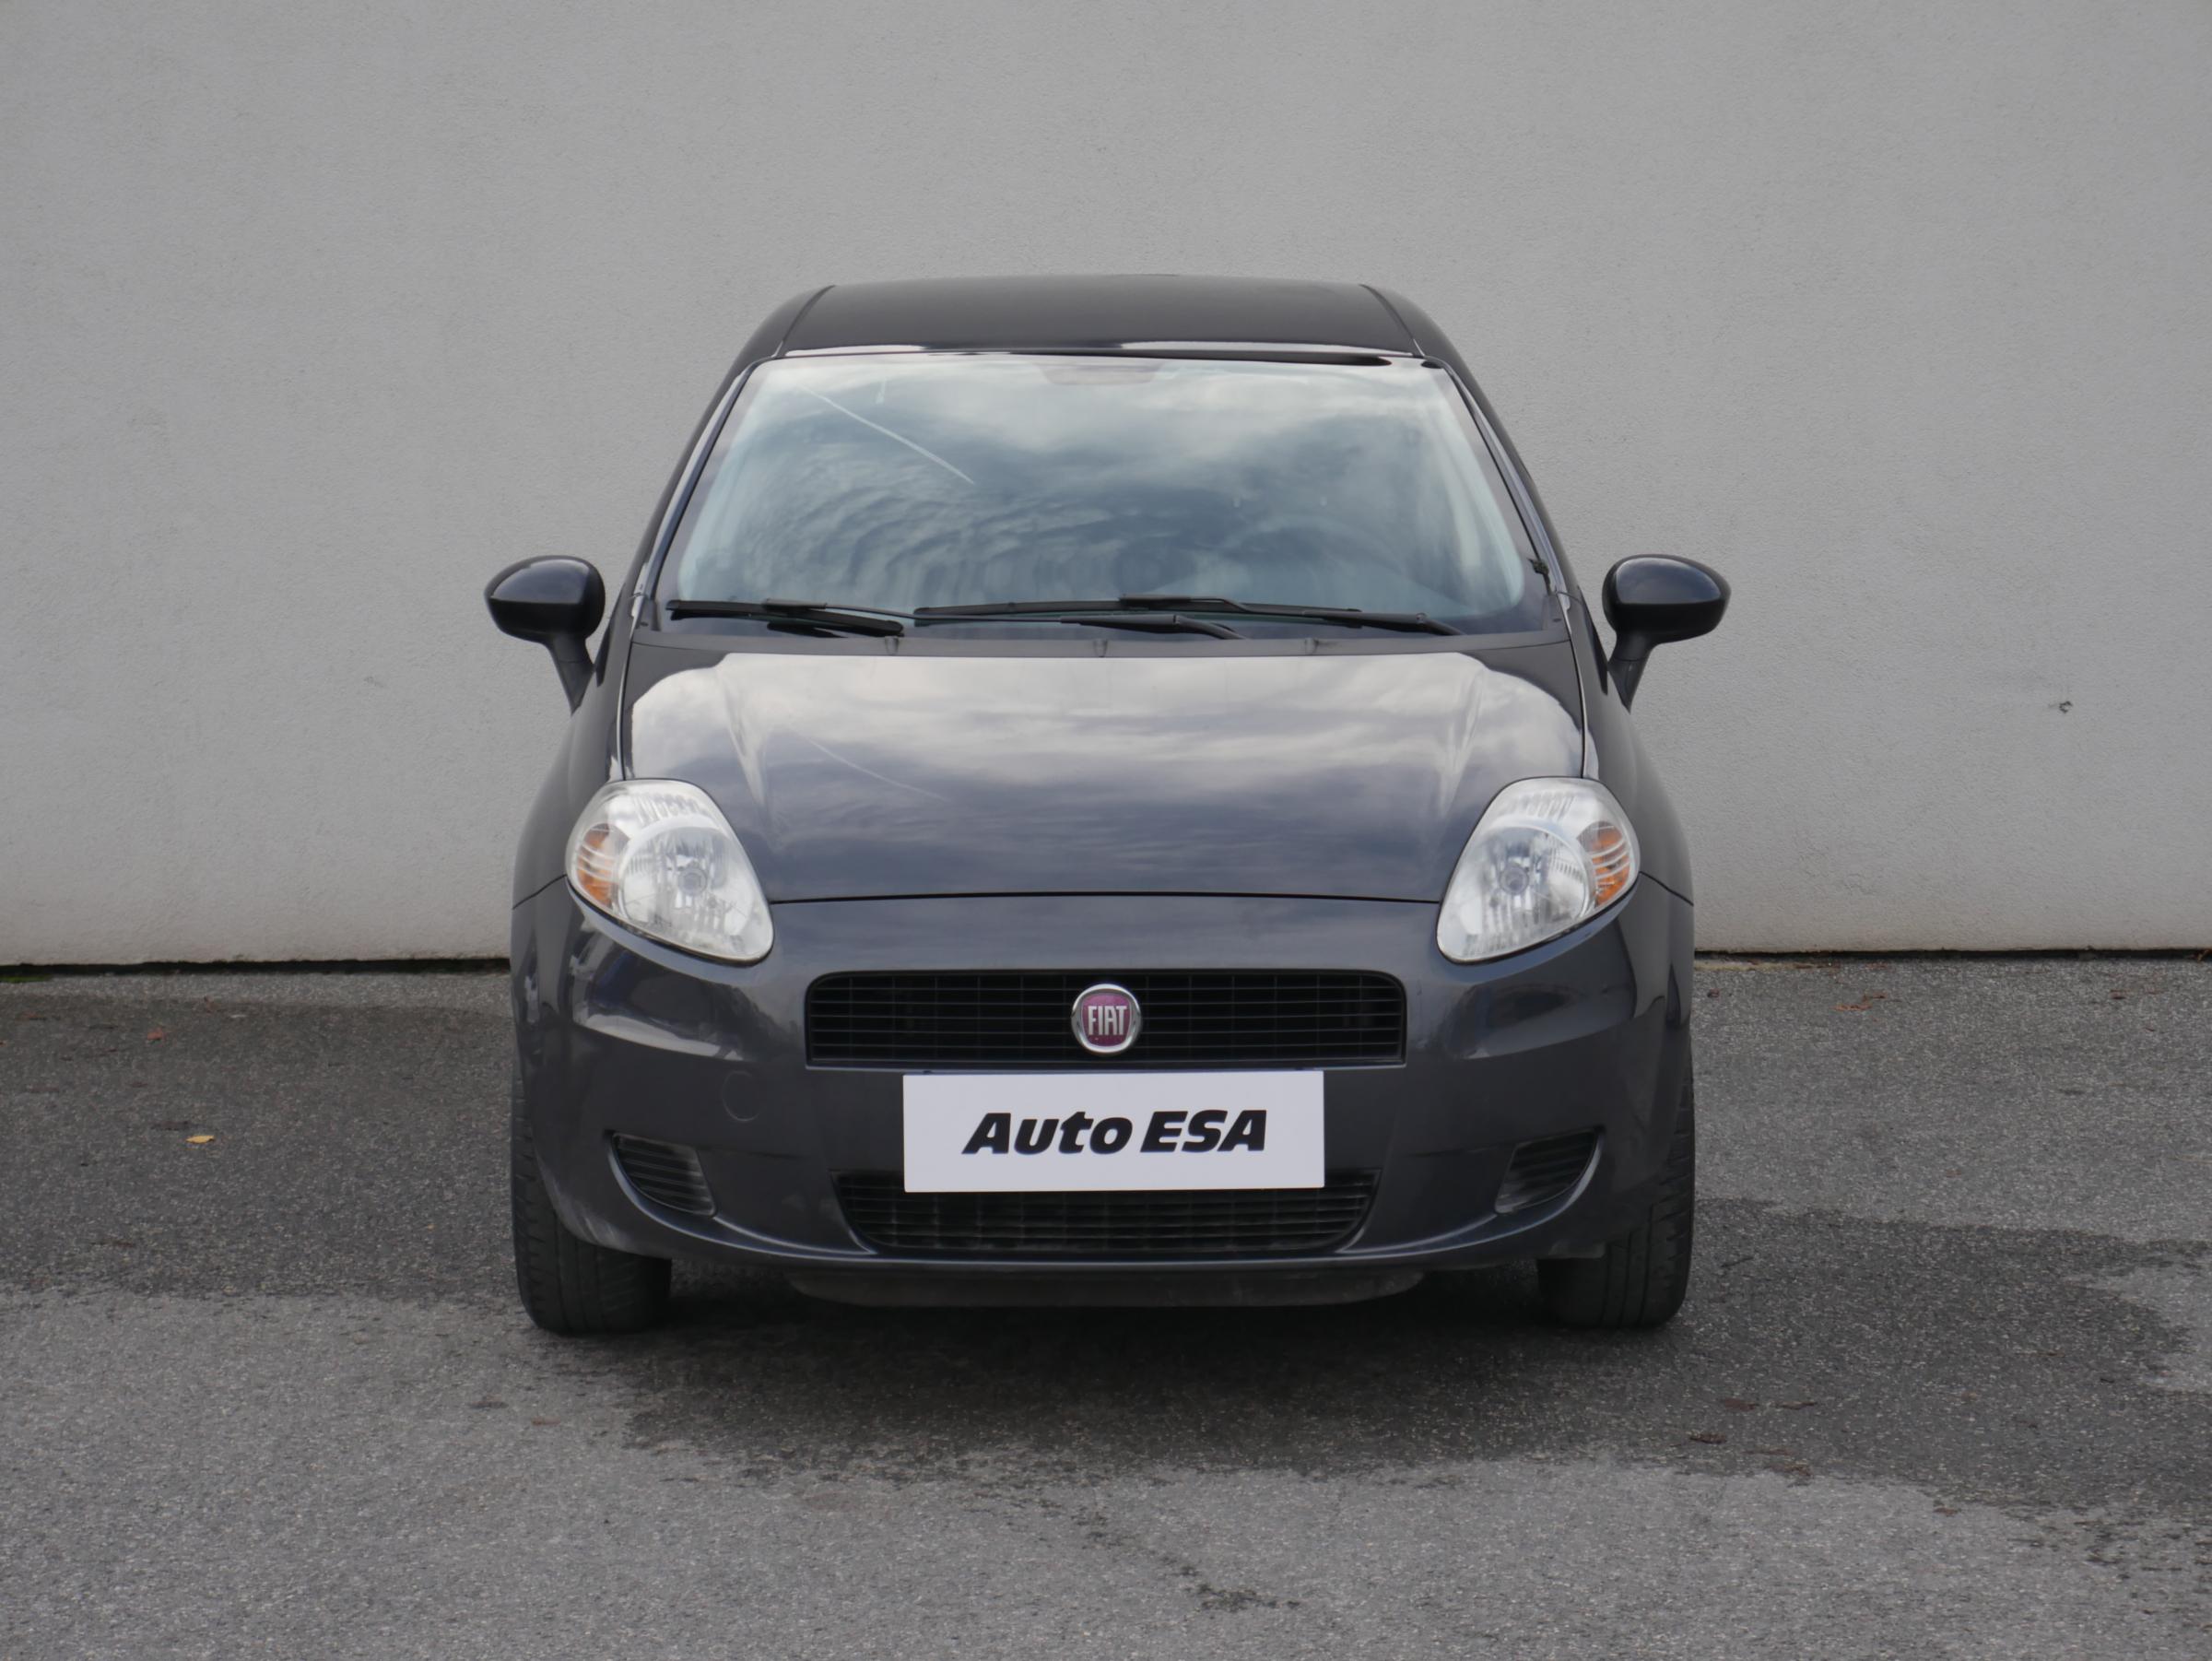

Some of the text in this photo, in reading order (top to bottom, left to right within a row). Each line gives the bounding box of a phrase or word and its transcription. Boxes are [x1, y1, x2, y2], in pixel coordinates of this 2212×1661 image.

[1088, 1005, 1127, 1036] FIAT
[961, 1109, 1267, 1155] Auto ESA
